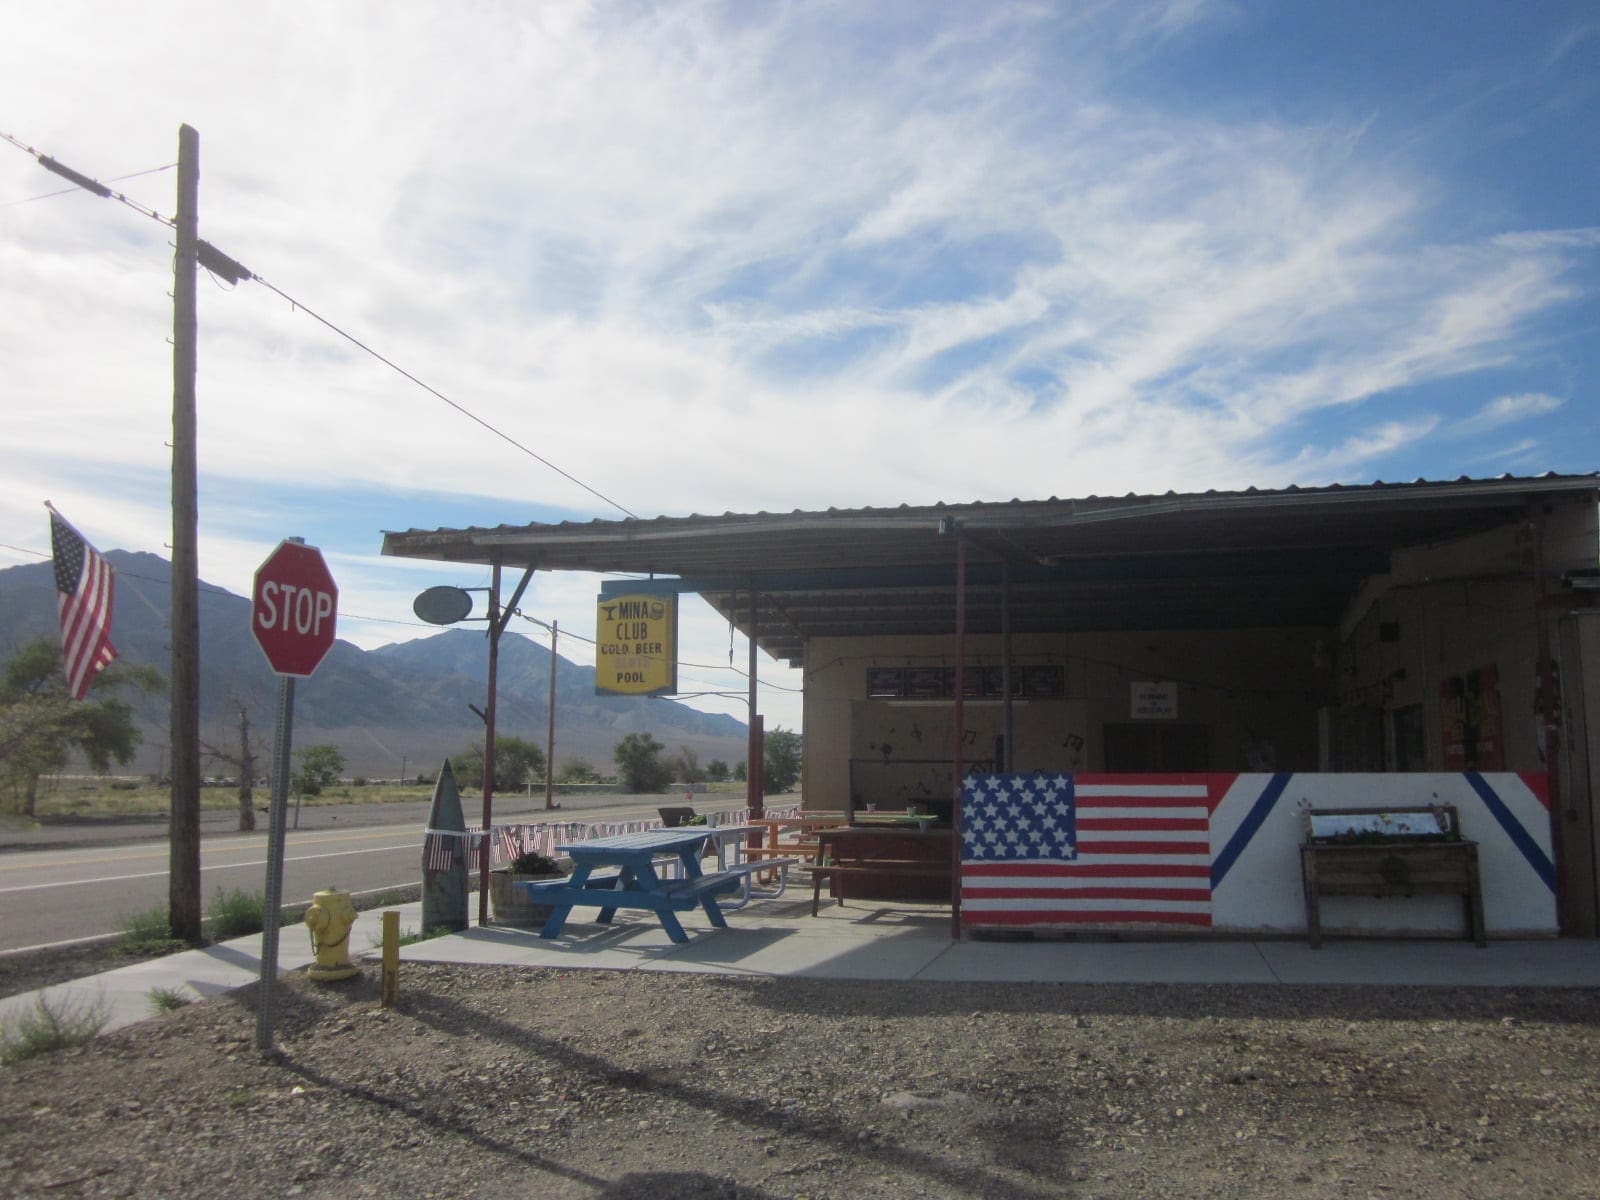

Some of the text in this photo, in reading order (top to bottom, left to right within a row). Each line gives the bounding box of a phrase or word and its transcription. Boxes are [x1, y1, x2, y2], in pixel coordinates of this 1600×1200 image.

[259, 581, 332, 636] STOP
[618, 601, 649, 619] MINA
[616, 622, 647, 640] CLUB
[602, 642, 662, 654] COLD BEER
[616, 671, 646, 684] POOL
